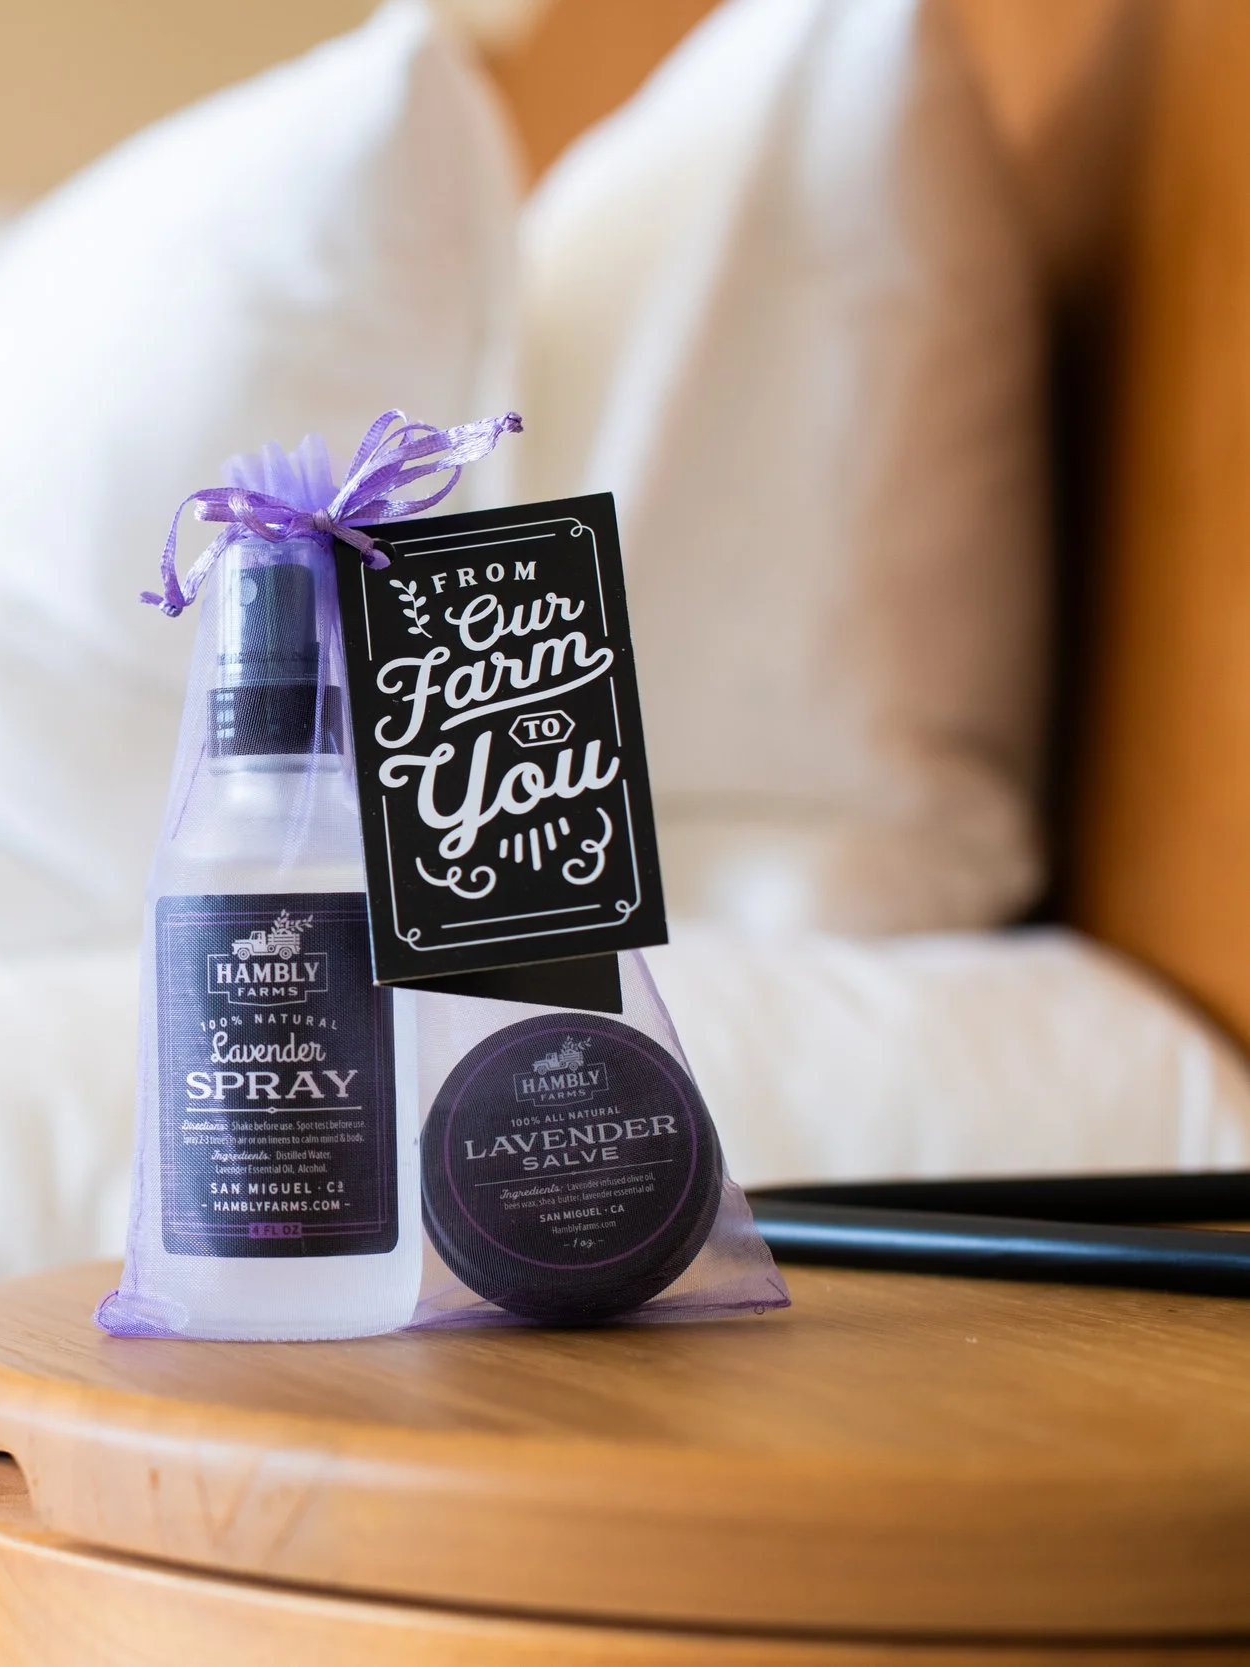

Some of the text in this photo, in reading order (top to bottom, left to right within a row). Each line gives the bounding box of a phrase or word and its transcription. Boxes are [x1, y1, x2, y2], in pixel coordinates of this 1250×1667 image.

[431, 561, 537, 594] FROM
[444, 592, 584, 651] Our
[374, 631, 614, 749] Farm
[523, 716, 561, 740] TO
[378, 730, 620, 860] You
[216, 962, 320, 984] HAMBLY
[238, 986, 298, 997] FARMS
[200, 1014, 338, 1032] 100% NATURAL
[210, 1031, 326, 1063] Lavender
[186, 1069, 358, 1100] SPRAY
[521, 1068, 602, 1095] HAMBLY
[540, 1088, 587, 1102] FARMS
[231, 1121, 253, 1131] Shake
[254, 1120, 278, 1131] before
[296, 1120, 314, 1132] Spot
[314, 1121, 329, 1130] test
[329, 1119, 352, 1130] before
[510, 1105, 621, 1128] 100% ALL NATURAL
[238, 1136, 247, 1144] air
[268, 1135, 291, 1144] linens
[291, 1136, 300, 1144] to
[301, 1135, 319, 1144] calm
[320, 1134, 339, 1143] mind
[347, 1133, 365, 1143] body.
[463, 1114, 678, 1160] LAVENDER
[276, 1150, 307, 1160] Distilled
[522, 1146, 619, 1172] SALVE
[248, 1164, 281, 1174] Essential
[282, 1164, 295, 1174] Oil,
[297, 1163, 328, 1173] Alcohol.
[210, 1182, 240, 1194] SAN
[248, 1182, 312, 1194] MIGUEL
[567, 1180, 599, 1191] Lavender
[599, 1175, 626, 1187] infused
[627, 1174, 644, 1183] olive
[214, 1200, 340, 1212] HAMBLYFARMS.COM
[504, 1202, 521, 1210] bees
[539, 1197, 556, 1206] shea
[582, 1189, 612, 1200] lavender
[613, 1184, 644, 1196] essential
[539, 1204, 625, 1222] SAN MIGUEL CA
[252, 1225, 299, 1236] 4 FL OZ
